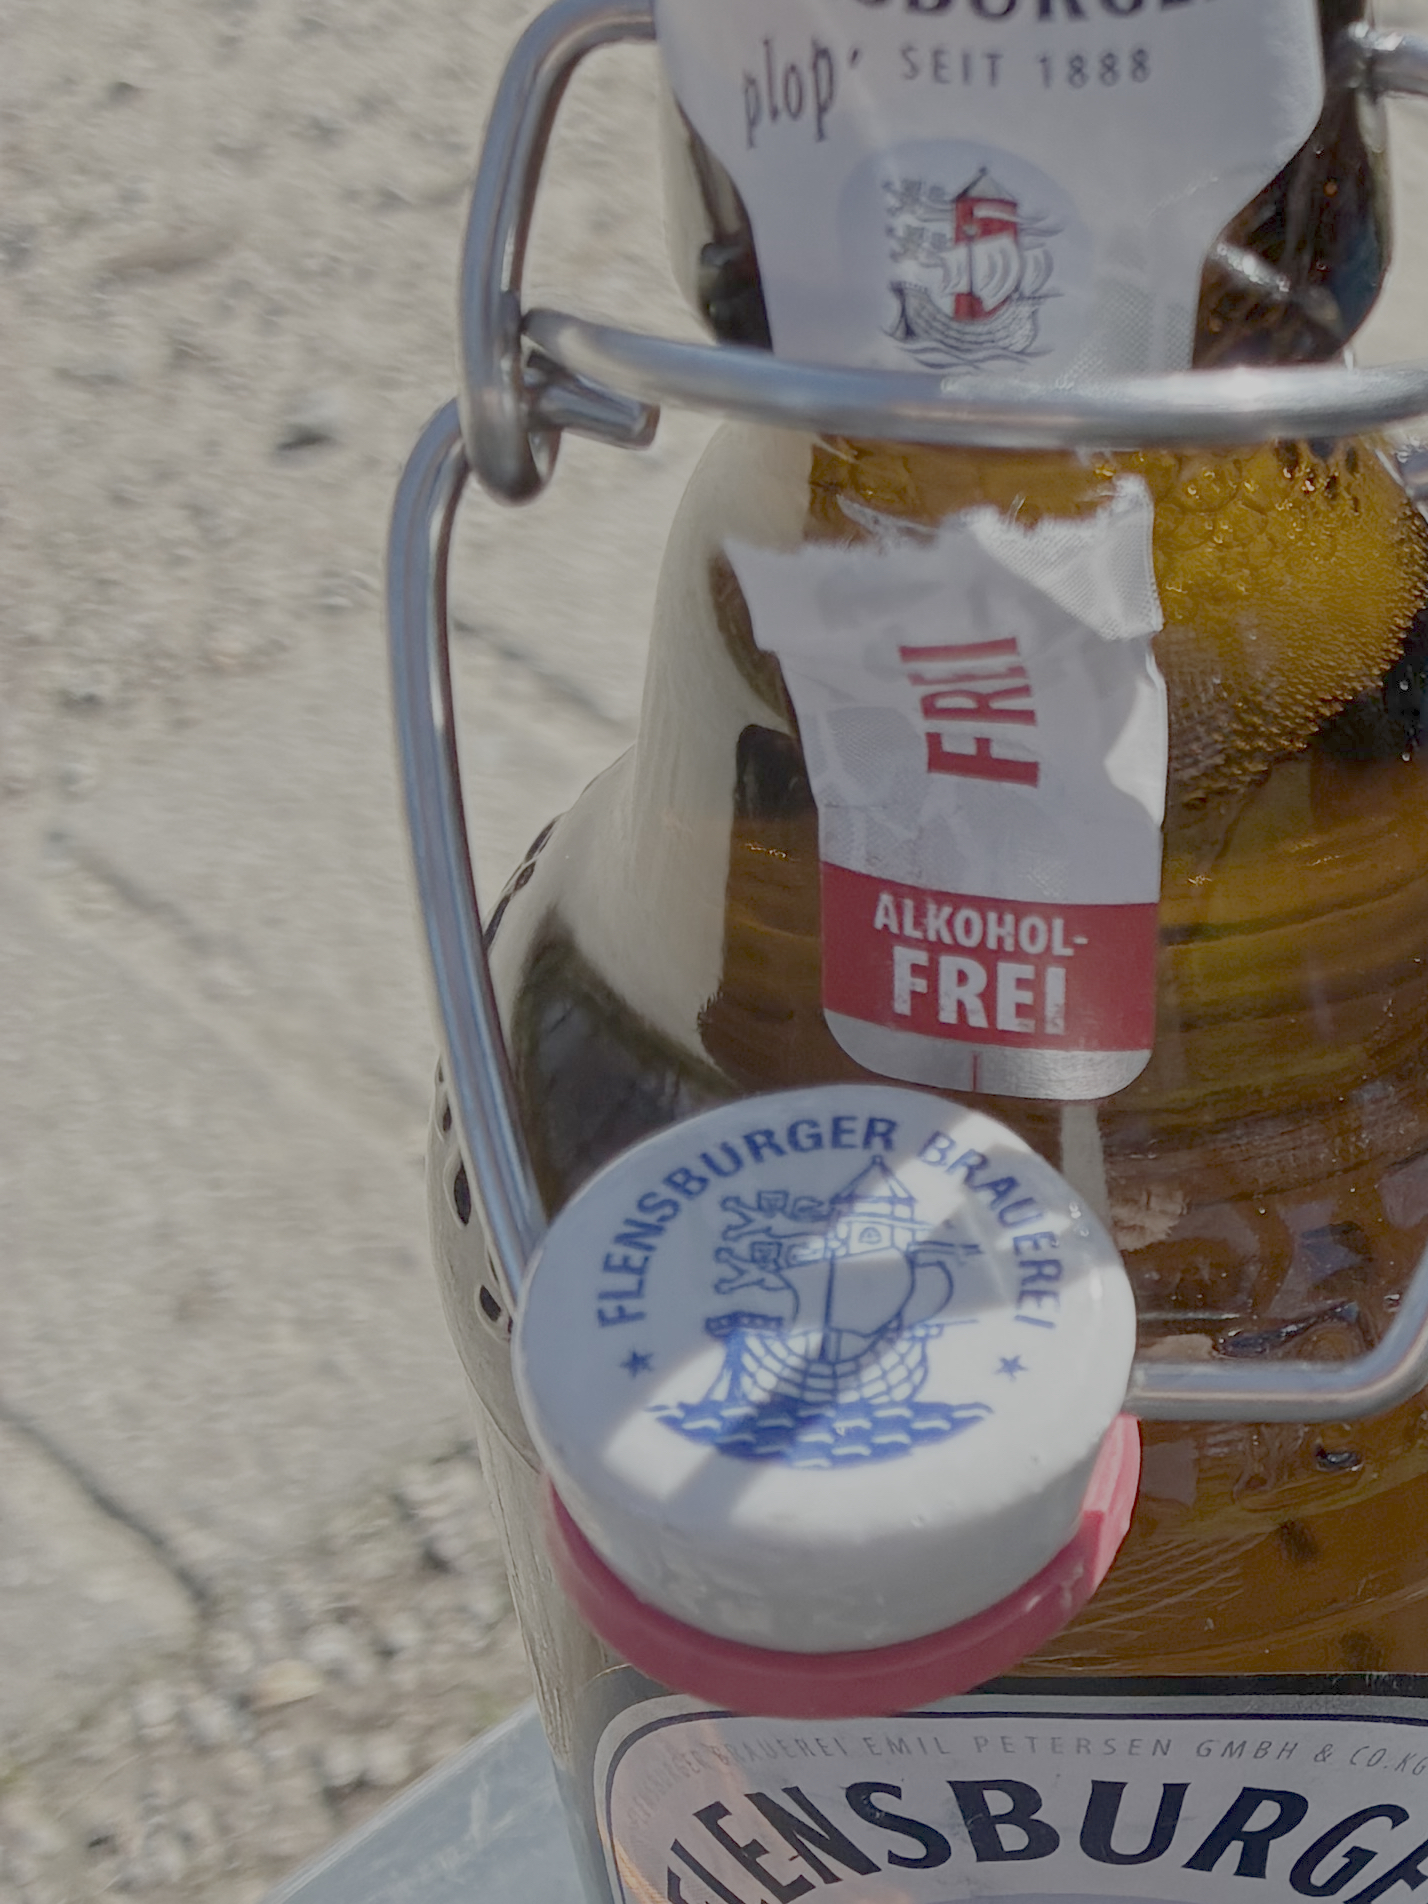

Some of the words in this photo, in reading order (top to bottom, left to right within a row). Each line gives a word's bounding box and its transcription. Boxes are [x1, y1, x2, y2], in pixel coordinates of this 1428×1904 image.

[902, 44, 1004, 89] SEIT
[1039, 47, 1152, 89] 1888
[872, 892, 1090, 956] ALKOHOL-
[891, 945, 1067, 1036] FREI
[595, 1115, 899, 1330] FLENSBURGER
[917, 1129, 1067, 1332] BRAUEREI
[714, 1736, 848, 1767] BRAUEREI
[864, 1736, 951, 1757] EMIL
[973, 1735, 1172, 1757] PETERSEN
[1195, 1738, 1298, 1760] GMBH
[1313, 1743, 1334, 1763] &
